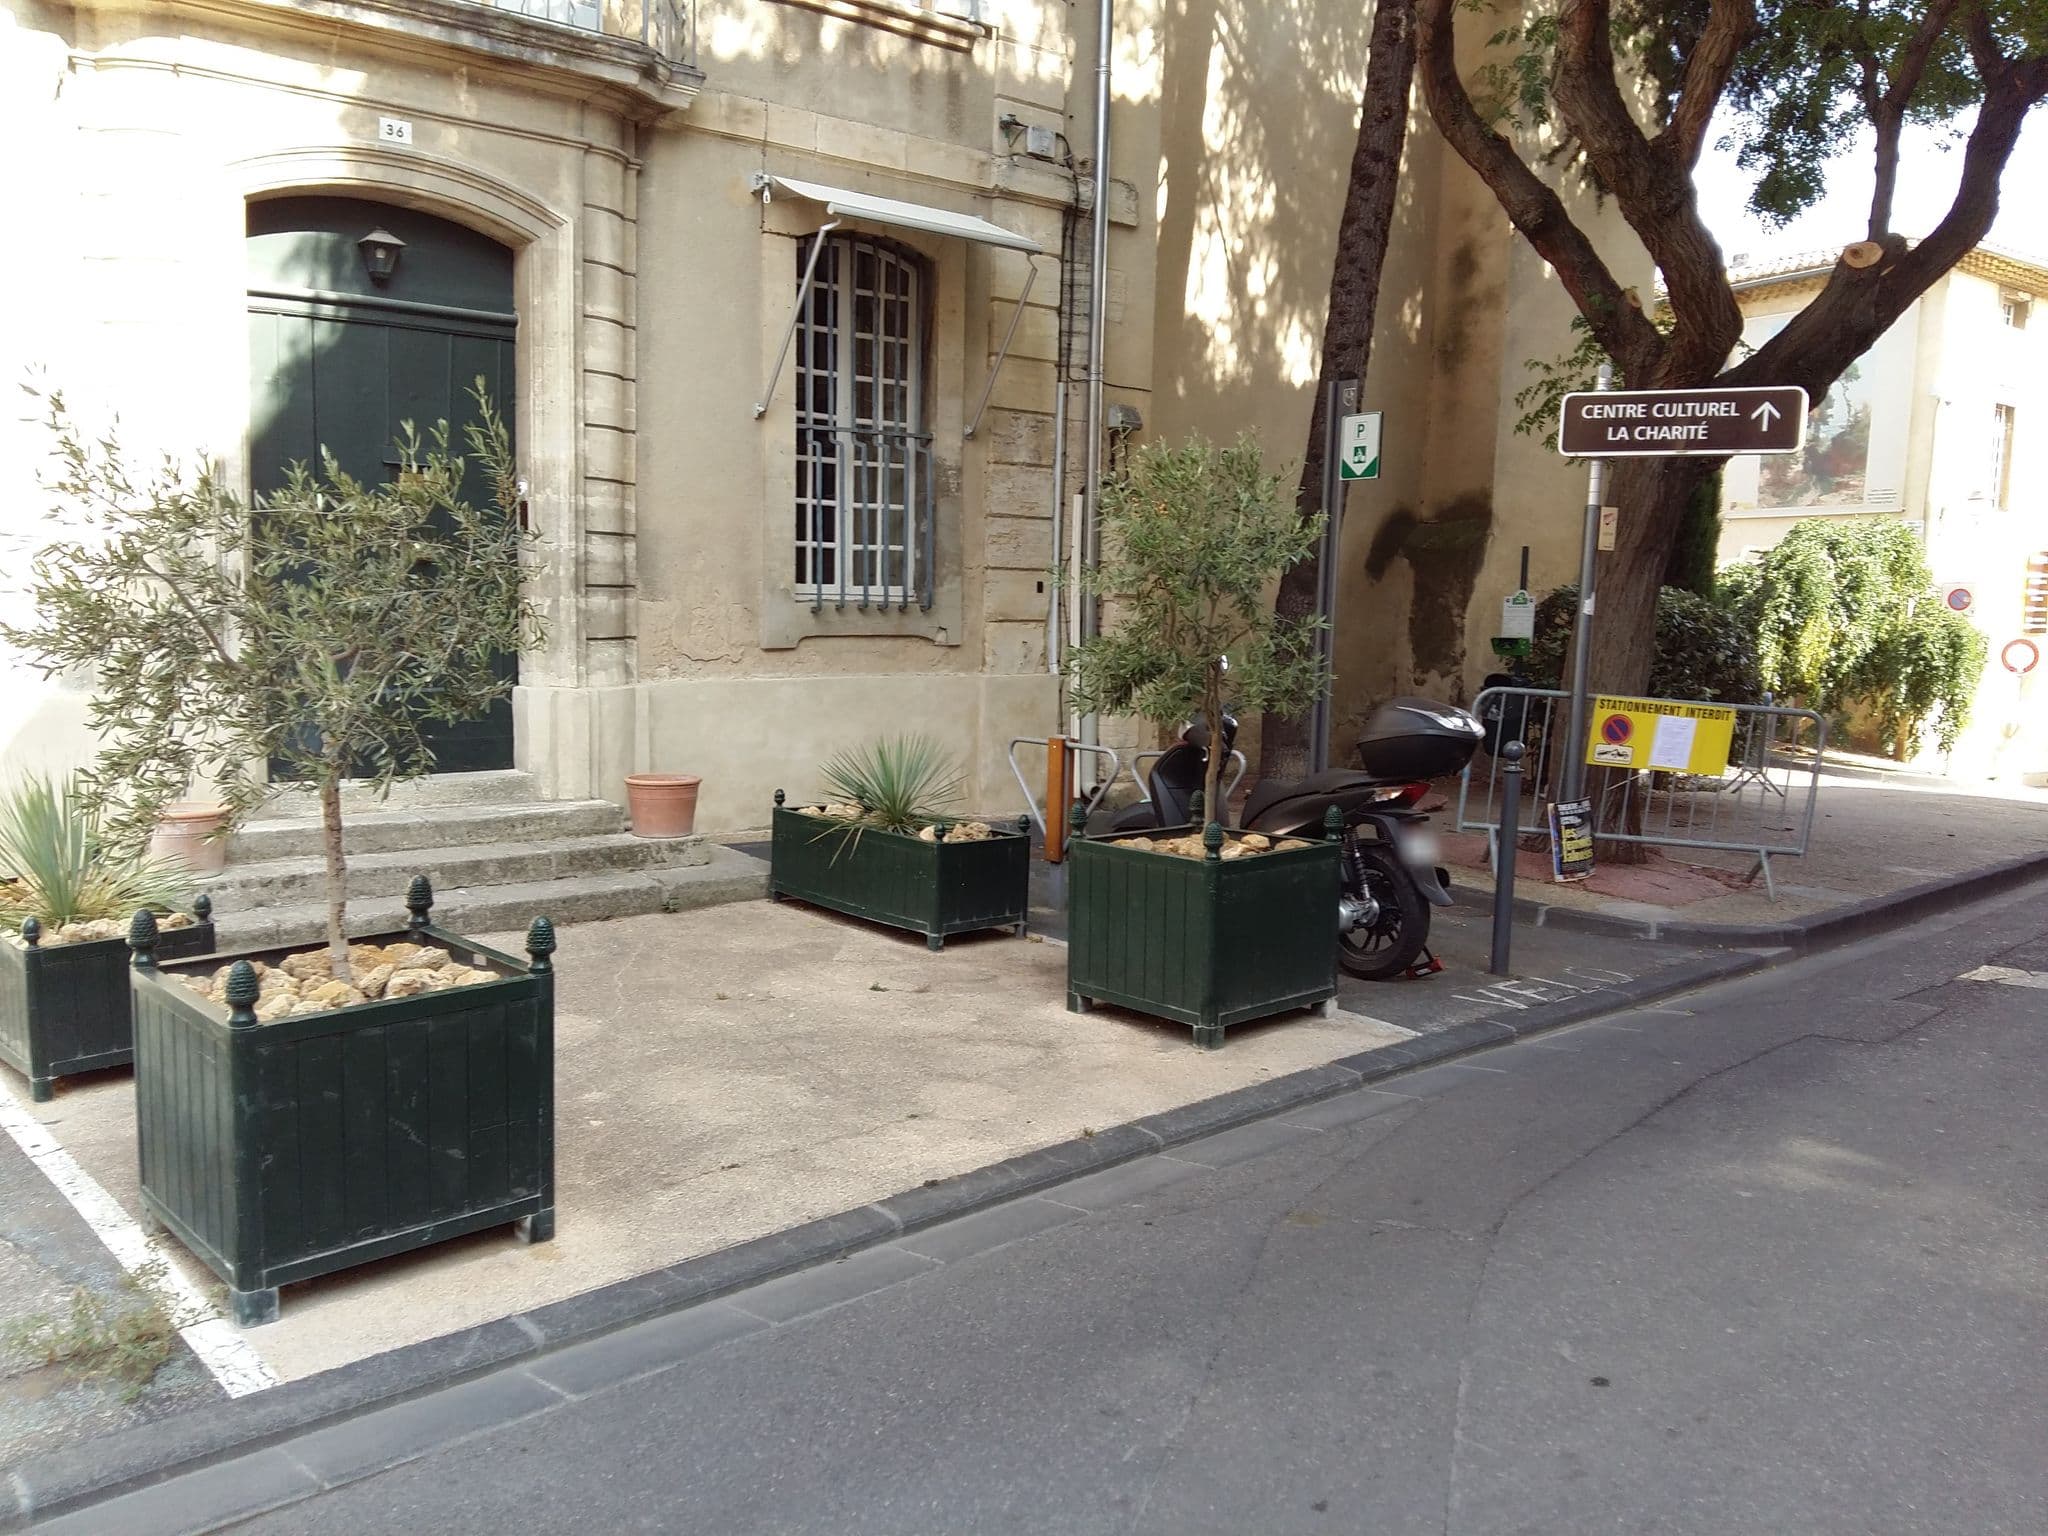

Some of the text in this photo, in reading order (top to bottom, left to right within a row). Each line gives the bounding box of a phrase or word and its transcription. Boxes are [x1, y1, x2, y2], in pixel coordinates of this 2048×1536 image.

[386, 123, 404, 138] 36
[1581, 401, 1740, 419] CENTRE CULTUREL
[1356, 423, 1366, 438] P
[1607, 421, 1709, 441] LA CHARITÉ
[1599, 698, 1732, 721] STATIONNEMENT INTERDIT
